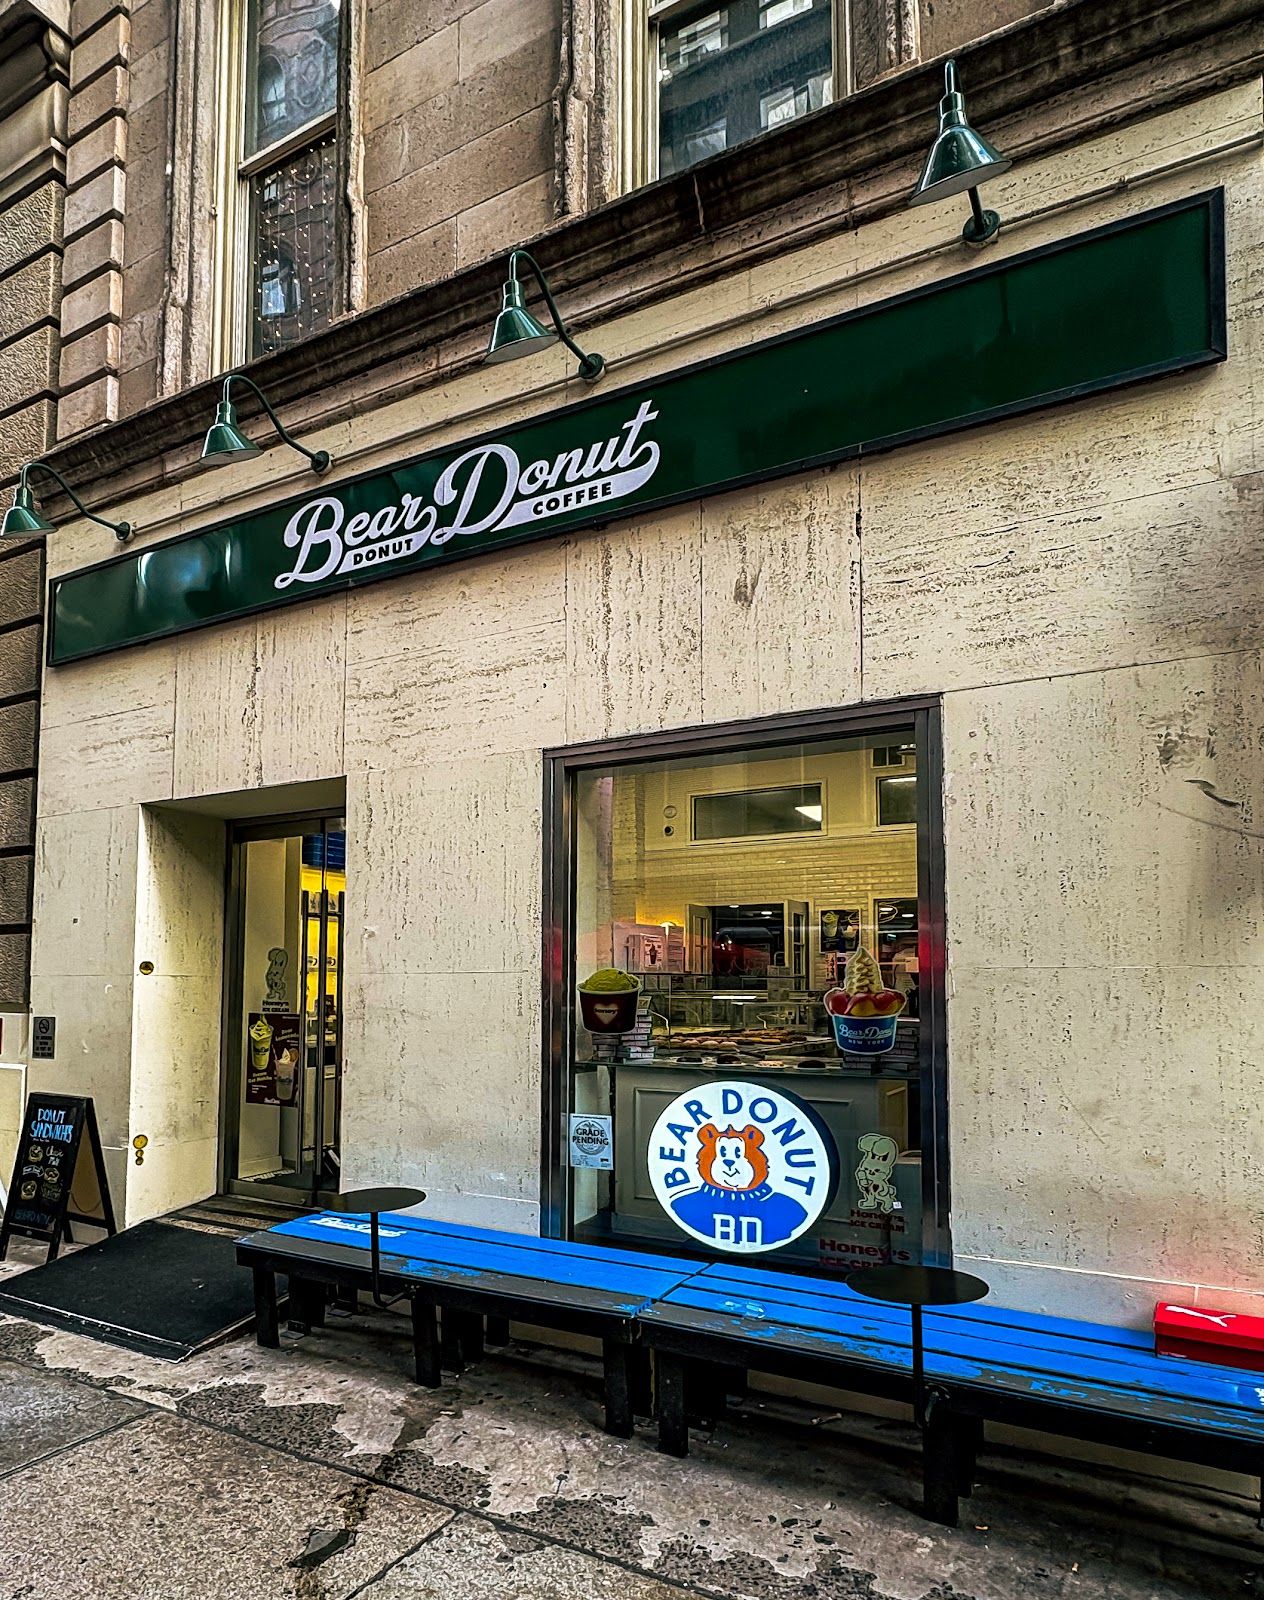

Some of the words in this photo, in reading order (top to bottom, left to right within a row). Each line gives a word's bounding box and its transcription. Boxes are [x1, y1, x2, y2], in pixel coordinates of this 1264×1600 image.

[274, 493, 436, 590] Bear
[430, 399, 661, 546] Donut
[531, 481, 613, 516] COFFEE
[352, 537, 413, 566] DONUT
[572, 1135, 610, 1146] PENDING
[576, 1127, 606, 1138] GRADE
[659, 1099, 713, 1189] BEAR
[722, 1088, 817, 1196] DONUT
[819, 1238, 911, 1261] Honey's
